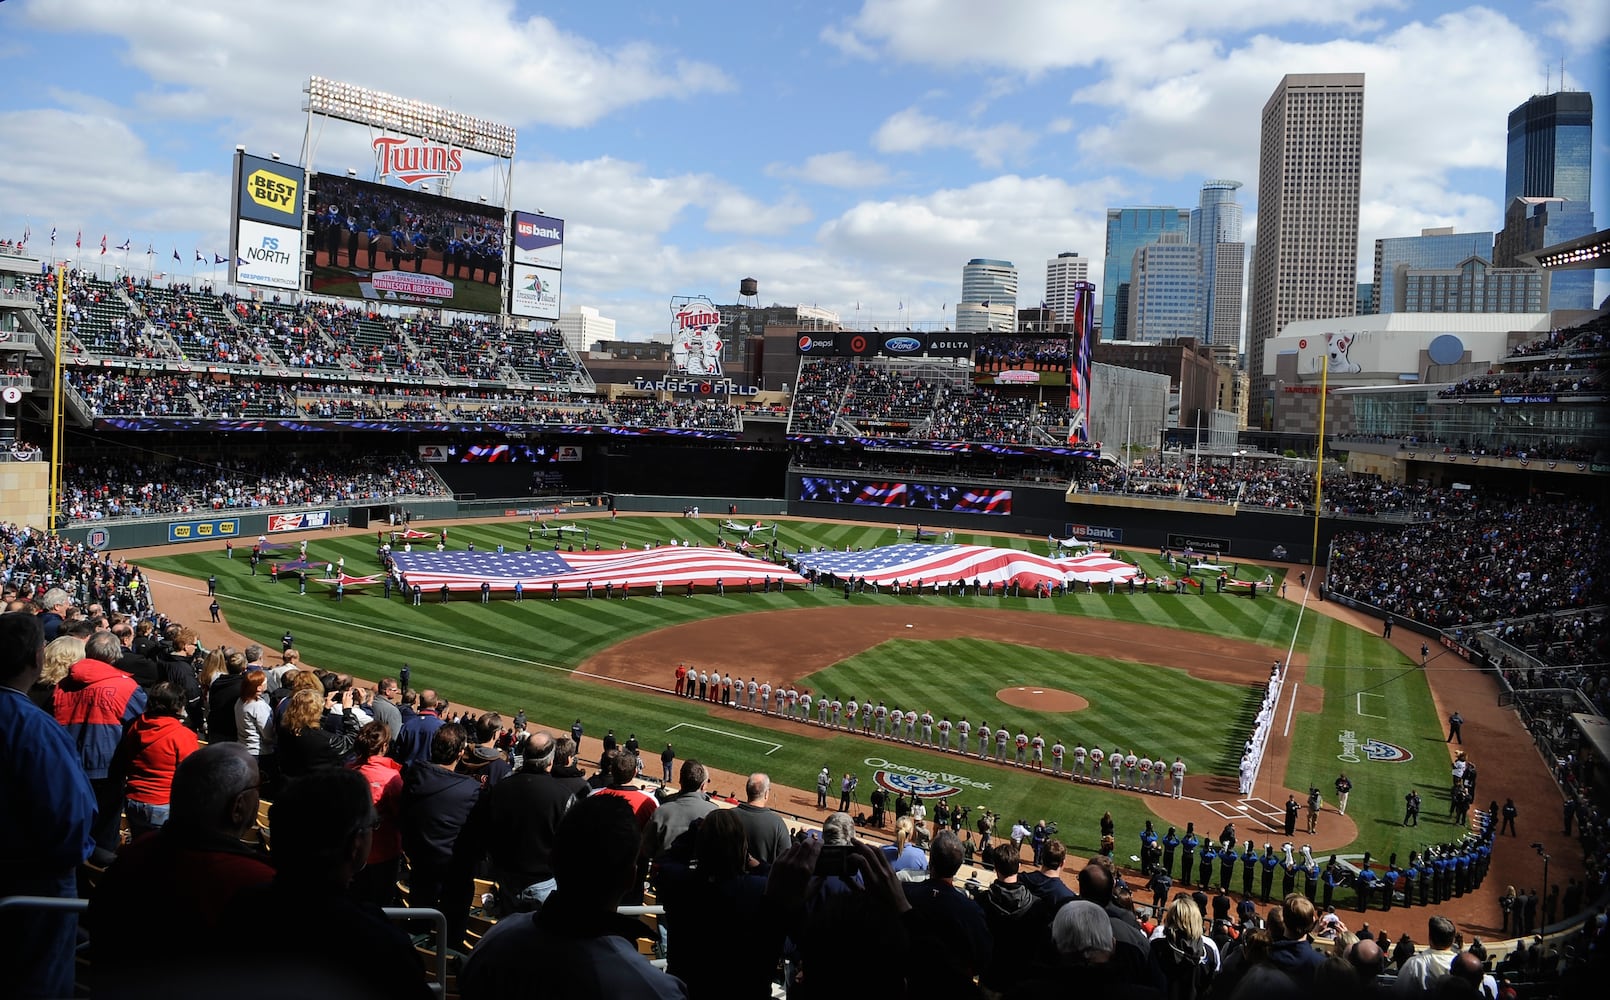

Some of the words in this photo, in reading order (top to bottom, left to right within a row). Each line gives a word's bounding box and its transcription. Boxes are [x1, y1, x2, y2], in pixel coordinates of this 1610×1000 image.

[373, 137, 462, 175] Twins
[254, 175, 295, 197] BEST
[254, 187, 290, 206] BUY
[261, 236, 279, 250] FS
[247, 247, 290, 265] NORTH
[374, 280, 411, 292] MINNESOTA
[413, 284, 433, 294] BRASS
[434, 287, 451, 297] BAND
[676, 310, 720, 330] Twins
[812, 339, 833, 348] pepsi
[891, 340, 914, 350] Ford
[939, 341, 969, 349] DELTA
[10, 391, 15, 400] 3
[634, 380, 698, 393] TARGET
[714, 384, 760, 396] FIELD
[1185, 539, 1220, 549] CenturyLink
[864, 758, 940, 781] Opening
[939, 771, 993, 791] Week
